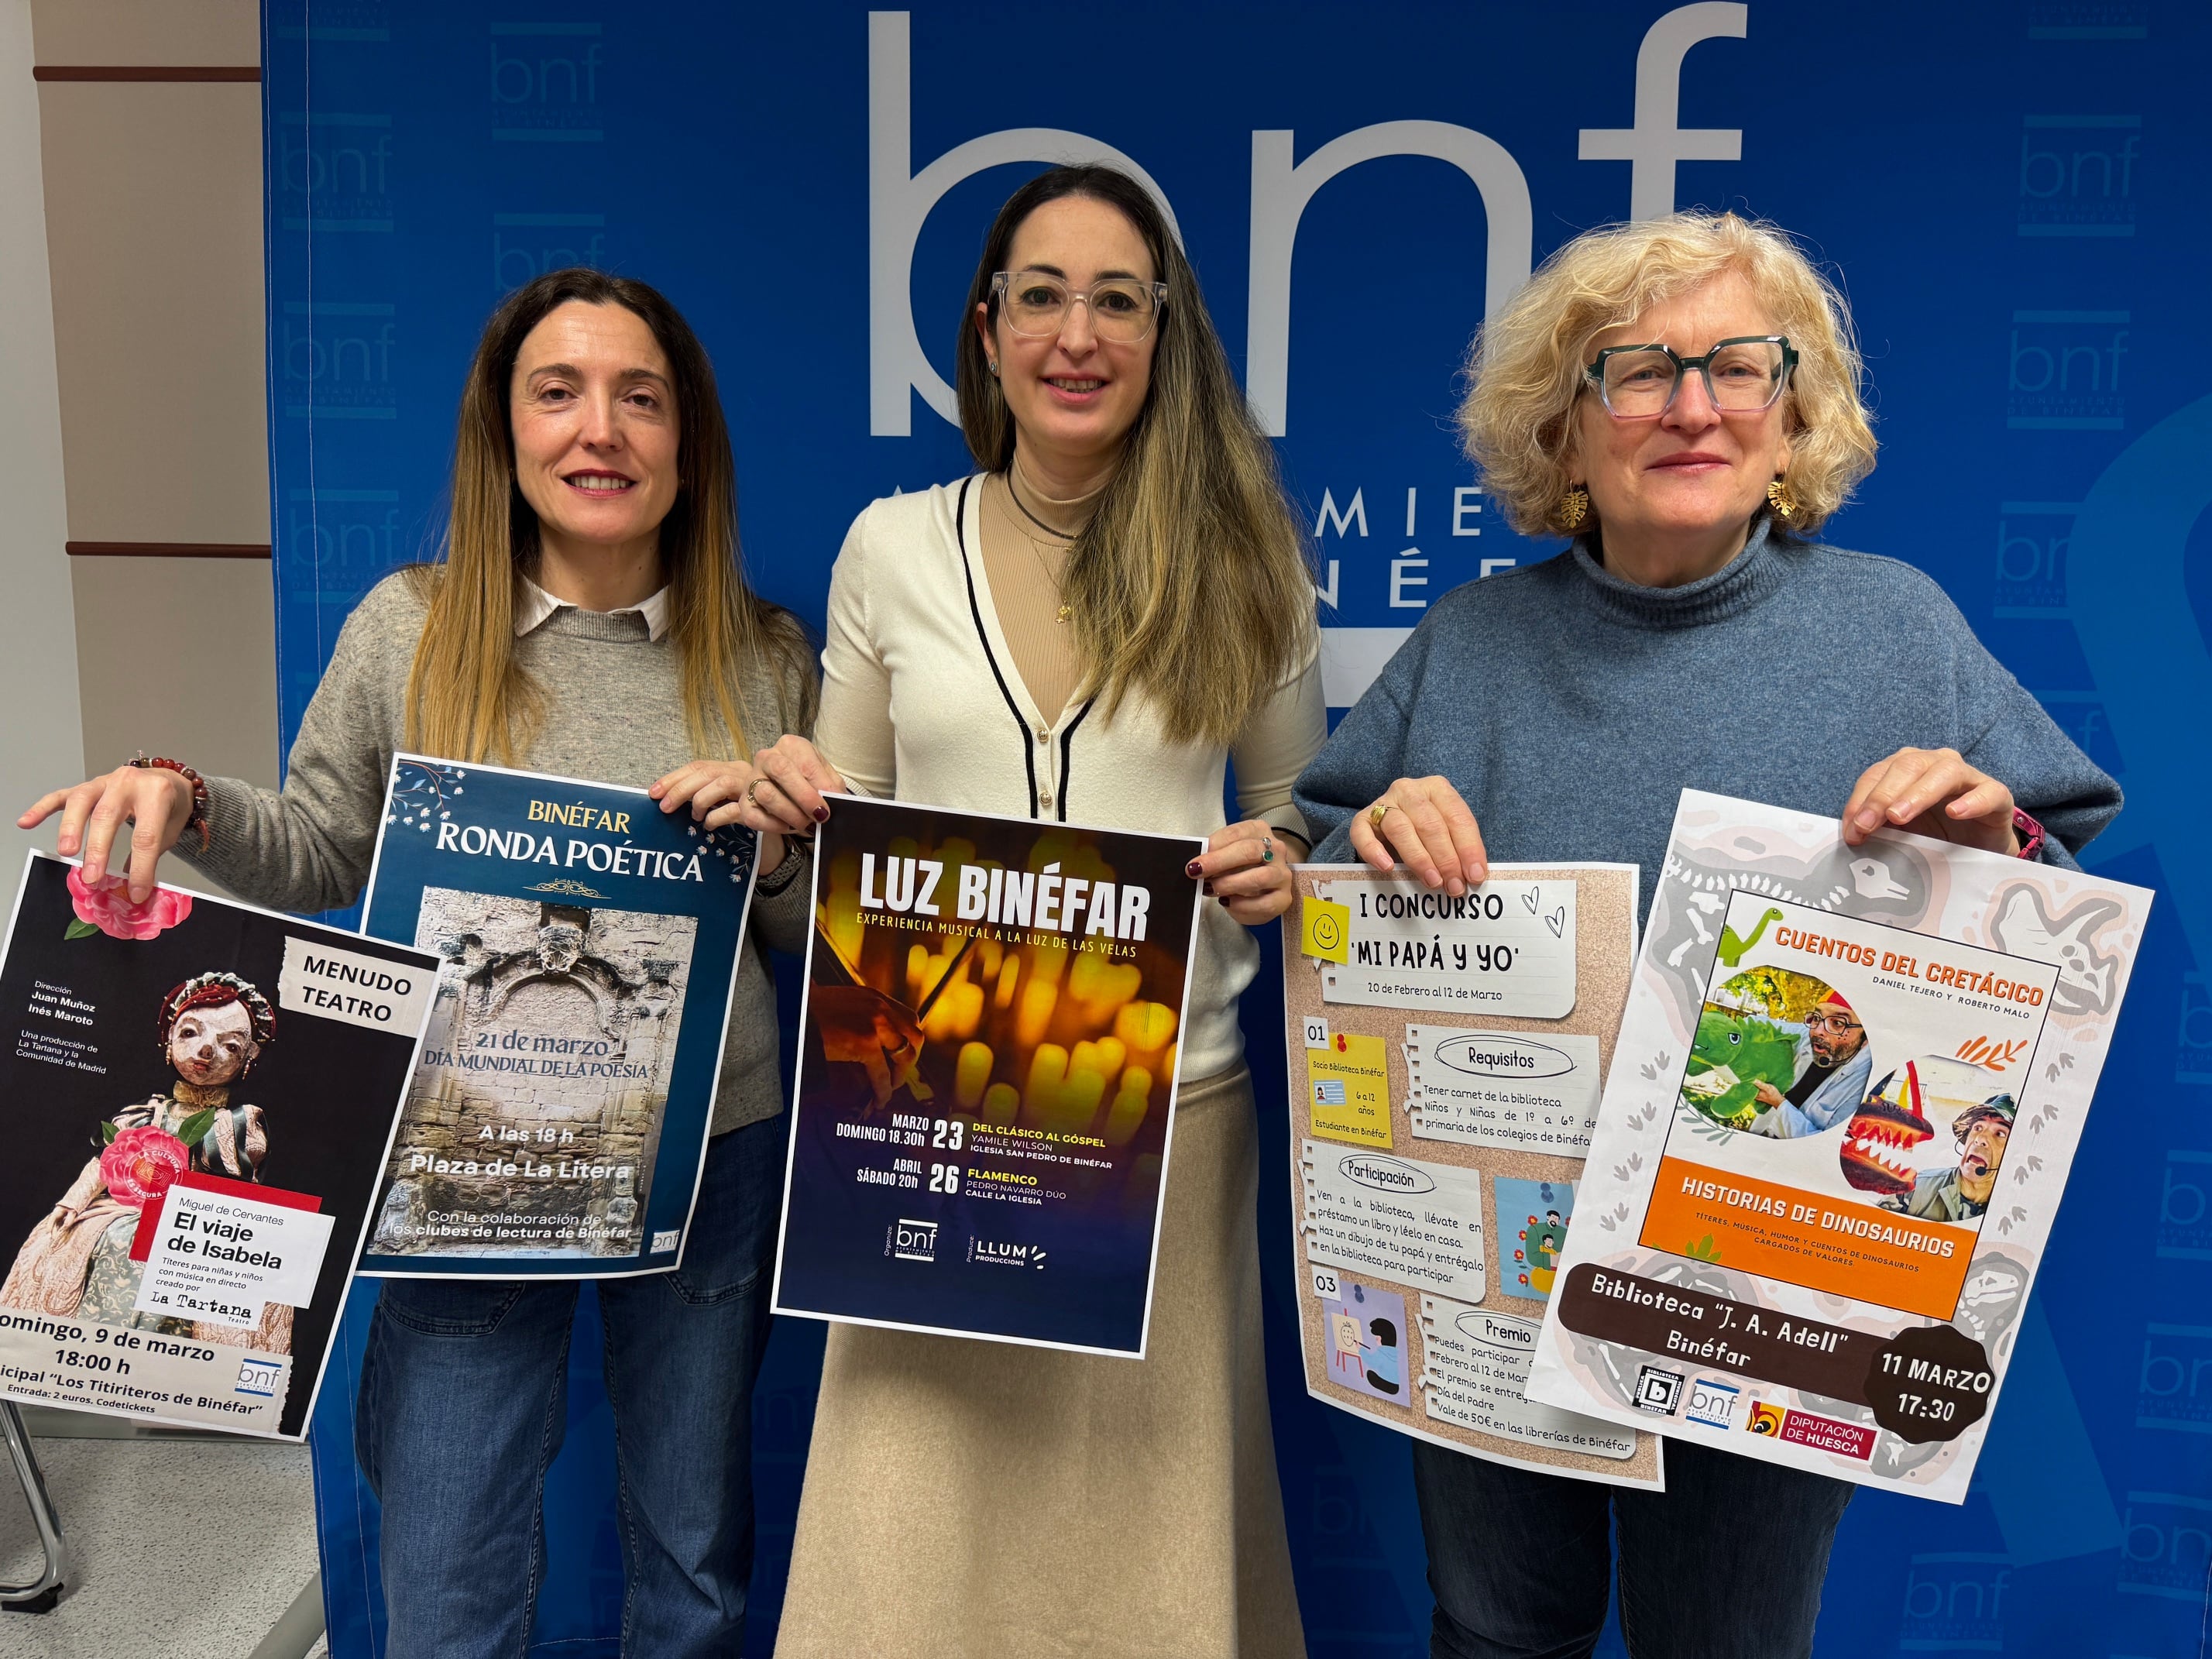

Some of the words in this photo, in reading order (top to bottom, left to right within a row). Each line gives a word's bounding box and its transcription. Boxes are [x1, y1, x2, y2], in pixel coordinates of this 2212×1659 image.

[491, 41, 601, 104] bnf
[868, 2, 1748, 438] bnf
[2009, 331, 2129, 392] bnf
[527, 800, 630, 834] BINÉFAR
[436, 822, 558, 867] RONDA
[565, 840, 704, 882] POÉTICA
[860, 853, 943, 915] LUZ
[957, 861, 1150, 942] BINÉFAR
[1360, 893, 1367, 917] I
[1376, 894, 1503, 920] CONCURSO
[857, 912, 933, 933] EXPERIENCIA
[939, 923, 989, 940] MUSICAL
[994, 930, 1001, 941] A
[1007, 931, 1021, 943] LA
[1026, 936, 1047, 946] LUZ
[1053, 938, 1067, 949] DE
[1073, 941, 1094, 952] LAS
[1100, 943, 1136, 957] VELAS
[1390, 934, 1444, 970] PAPÁ
[1453, 944, 1467, 971] Y
[304, 956, 411, 996] MENUDO
[1775, 926, 1876, 967] CUENTOS
[1881, 951, 1919, 979] DEL
[1926, 962, 2043, 1006] CRETÁCICO
[35, 981, 71, 995] Dirección
[1368, 982, 1379, 992] 20
[1382, 984, 1392, 993] de
[1395, 984, 1430, 997] Febrero
[1432, 987, 1441, 997] al
[1444, 987, 1453, 998] 12
[1455, 988, 1468, 998] de
[1471, 990, 1503, 1001] Marzo
[1872, 976, 1906, 993] DANIEL
[1910, 984, 1943, 1000] TEJERO
[1958, 996, 2000, 1013] ROBERTO
[2004, 1006, 2030, 1020] MALO
[29, 1004, 51, 1016] Inés
[55, 1010, 93, 1025] Maroto
[32, 991, 57, 1004] Juan
[60, 998, 95, 1012] Muñoz
[301, 985, 392, 1022] TEATRO
[21, 1030, 38, 1039] Una
[40, 1035, 85, 1050] producción
[88, 1043, 98, 1053] de
[476, 1033, 496, 1049] 21
[503, 1029, 530, 1053] de
[533, 1038, 609, 1056] marzo
[1308, 1025, 1325, 1041] 01
[16, 1049, 64, 1065] Comunidad
[66, 1059, 76, 1067] de
[78, 1062, 106, 1074] Madrid
[33, 1042, 62, 1055] Tartana
[1468, 1047, 1534, 1070] Requisitos
[424, 1048, 455, 1066] DÍA
[458, 1053, 534, 1075] MUNDIAL
[541, 1060, 563, 1076] DE
[566, 1062, 587, 1077] LA
[590, 1062, 647, 1079] POESÍA
[1424, 1085, 1448, 1097] Tener
[1451, 1088, 1482, 1101] carnet
[1484, 1091, 1496, 1101] de
[1499, 1091, 1508, 1102] la
[1511, 1091, 1561, 1108] biblioteca
[479, 1125, 495, 1139] A
[500, 1127, 529, 1142] las
[537, 1128, 556, 1142] 18
[559, 1128, 573, 1143] h
[836, 1123, 886, 1142] DOMINGO
[888, 1129, 925, 1147] 18.30h
[892, 1114, 929, 1131] MARZO
[933, 1119, 963, 1151] 23
[973, 1123, 994, 1134] DEL
[996, 1126, 1043, 1139] CLÁSICO
[1046, 1132, 1060, 1141] AL
[1063, 1133, 1106, 1148] GÓSPEL
[1315, 1119, 1349, 1132] Estudiante
[1352, 1126, 1359, 1135] en
[1361, 1127, 1386, 1139] Binéfar
[971, 1135, 1008, 1146] YAMILE
[1012, 1139, 1053, 1152] WILSON
[410, 1155, 476, 1175] Plaza
[486, 1159, 517, 1177] de
[524, 1160, 551, 1177] La
[558, 1160, 630, 1179] Litera
[893, 1158, 922, 1174] ABRIL
[970, 1145, 1004, 1156] IGLESIA
[1006, 1149, 1024, 1157] SAN
[1026, 1151, 1057, 1162] PEDRO
[1074, 1156, 1112, 1170] BINÉFAR
[857, 1168, 896, 1186] SÁBADO
[898, 1174, 918, 1189] 20h
[929, 1163, 960, 1194] 26
[968, 1169, 1038, 1186] FLAMENCO
[1348, 1161, 1414, 1190] Participación
[966, 1190, 993, 1199] CALLE
[995, 1192, 1006, 1200] LA
[1008, 1194, 1042, 1205] IGLESIA
[179, 1197, 214, 1212] Miguel
[216, 1205, 229, 1214] de
[232, 1208, 284, 1226] Cervantes
[1681, 1176, 1787, 1221] HISTORIAS
[1791, 1202, 1817, 1226] DE
[1821, 1209, 1955, 1259] DINOSAURIOS
[174, 1211, 198, 1231] El
[203, 1220, 253, 1242] viaje
[389, 1222, 413, 1235] los
[416, 1224, 470, 1237] clubes
[472, 1225, 493, 1238] de
[496, 1227, 552, 1238] lectura
[555, 1227, 575, 1238] de
[578, 1225, 631, 1239] Binéfar
[897, 1224, 937, 1249] bnf
[167, 1235, 196, 1253] de
[202, 1241, 282, 1269] Isabela
[975, 1255, 1024, 1266] PRODUCCIONS
[977, 1240, 1027, 1259] LLUM
[1316, 1276, 1336, 1292] 03
[150, 1292, 168, 1304] La
[177, 1294, 251, 1318] Tartana
[1592, 1274, 1705, 1320] Biblioteca
[1746, 1314, 1768, 1336] A.
[0, 1315, 87, 1343] omingo,
[95, 1328, 108, 1342] 9
[114, 1333, 140, 1349] de
[146, 1340, 215, 1362] marzo
[1486, 1320, 1531, 1343] Premio
[55, 1349, 111, 1372] 18:00
[117, 1358, 131, 1374] h
[1667, 1331, 1750, 1367] Binéfar
[238, 1364, 282, 1385] bnf
[1881, 1352, 1901, 1375] 11
[1908, 1360, 1990, 1395] MARZO
[7, 1385, 52, 1398] Entrada:
[62, 1393, 93, 1405] euros.
[96, 1399, 155, 1413] Codetickets
[1692, 1388, 1738, 1417] bnf
[1898, 1393, 1955, 1423] 17:30
[1790, 1414, 1863, 1442] DIPUTACIÓN
[1786, 1428, 1804, 1441] DE
[1806, 1431, 1859, 1455] HUESCA
